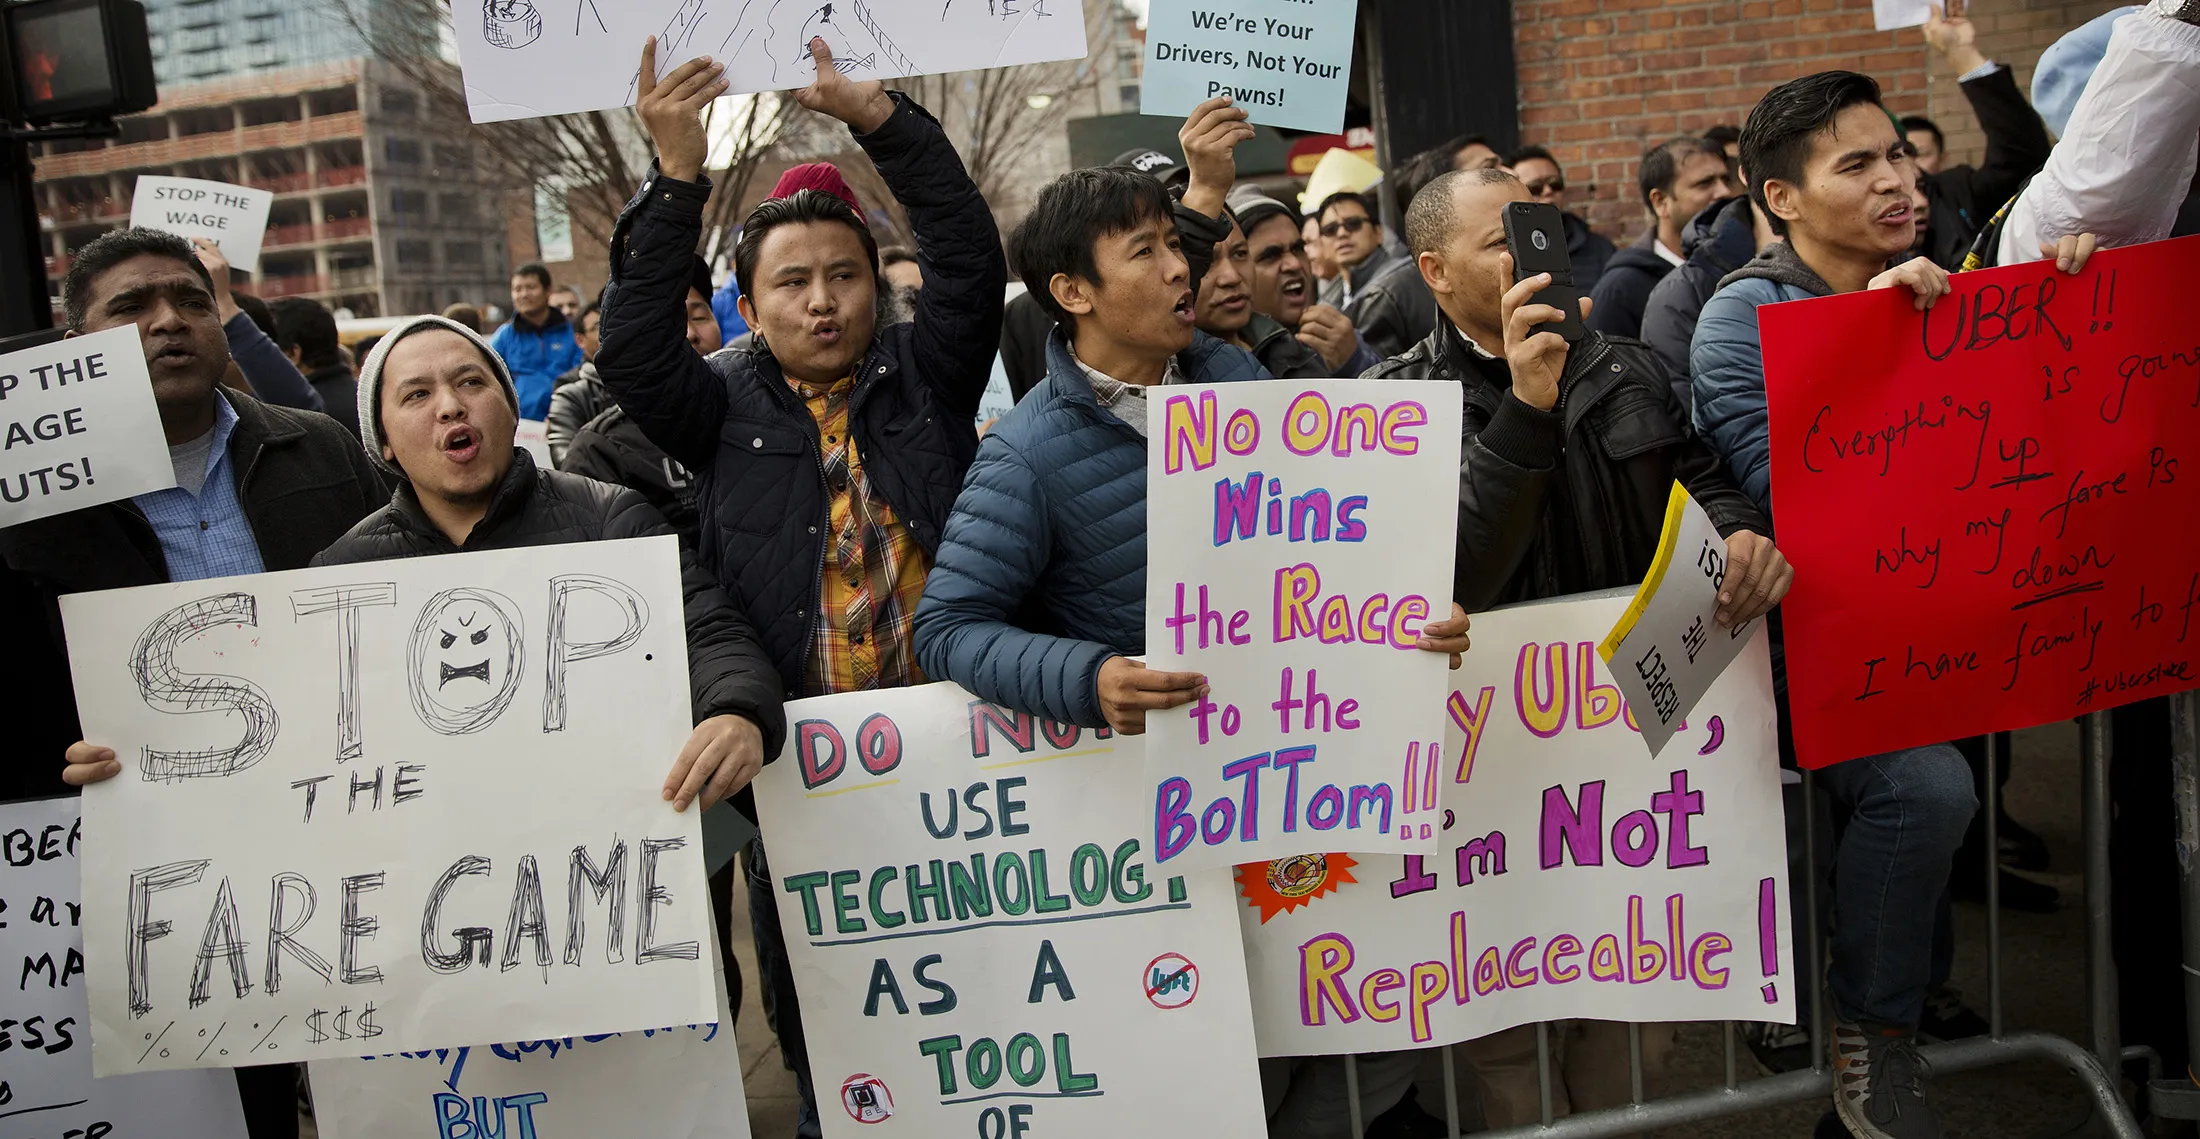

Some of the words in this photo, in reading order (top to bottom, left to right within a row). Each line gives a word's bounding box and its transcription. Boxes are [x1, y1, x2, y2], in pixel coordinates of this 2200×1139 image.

[1192, 11, 1257, 34] We’re
[1264, 17, 1313, 41] Your
[1156, 43, 1239, 70] Drivers,
[1247, 50, 1286, 72] Not
[1292, 56, 1341, 79] Your
[1207, 81, 1285, 107] Pawns!
[154, 186, 206, 201] STOP
[214, 192, 252, 210] THE
[166, 211, 229, 230] WAGE
[1921, 276, 2073, 361] UBER
[29, 353, 108, 391] THE
[5, 407, 87, 450] AGE
[1165, 389, 1261, 475] No
[1281, 390, 1428, 457] One
[1803, 395, 1991, 491] Everything
[2042, 364, 2080, 402] is
[0, 457, 95, 503] UTS!
[1999, 435, 2042, 491] up
[1213, 471, 1369, 547] Wins
[1875, 526, 1940, 589] why
[1966, 508, 2011, 575] my
[2039, 470, 2128, 540] fare
[2147, 446, 2179, 489] is
[2012, 545, 2116, 589] down
[1165, 582, 1251, 655] the
[1273, 563, 1430, 650] Race
[1855, 657, 1888, 702] I
[1904, 645, 1980, 682] have
[2001, 605, 2104, 691] family
[2130, 585, 2163, 631] to
[1189, 675, 1242, 745] to
[1271, 666, 1361, 734] the
[1635, 644, 1680, 726] RESPECT
[795, 711, 902, 790] DO
[292, 761, 426, 823] THE
[920, 776, 1030, 841] USE
[1539, 769, 1710, 870] Not
[124, 858, 386, 1020] FARE
[420, 833, 700, 984] GAME
[863, 953, 958, 1016] AS
[1027, 939, 1077, 1004] A
[918, 1032, 1099, 1095] TOOL
[433, 1092, 548, 1139] BUT
